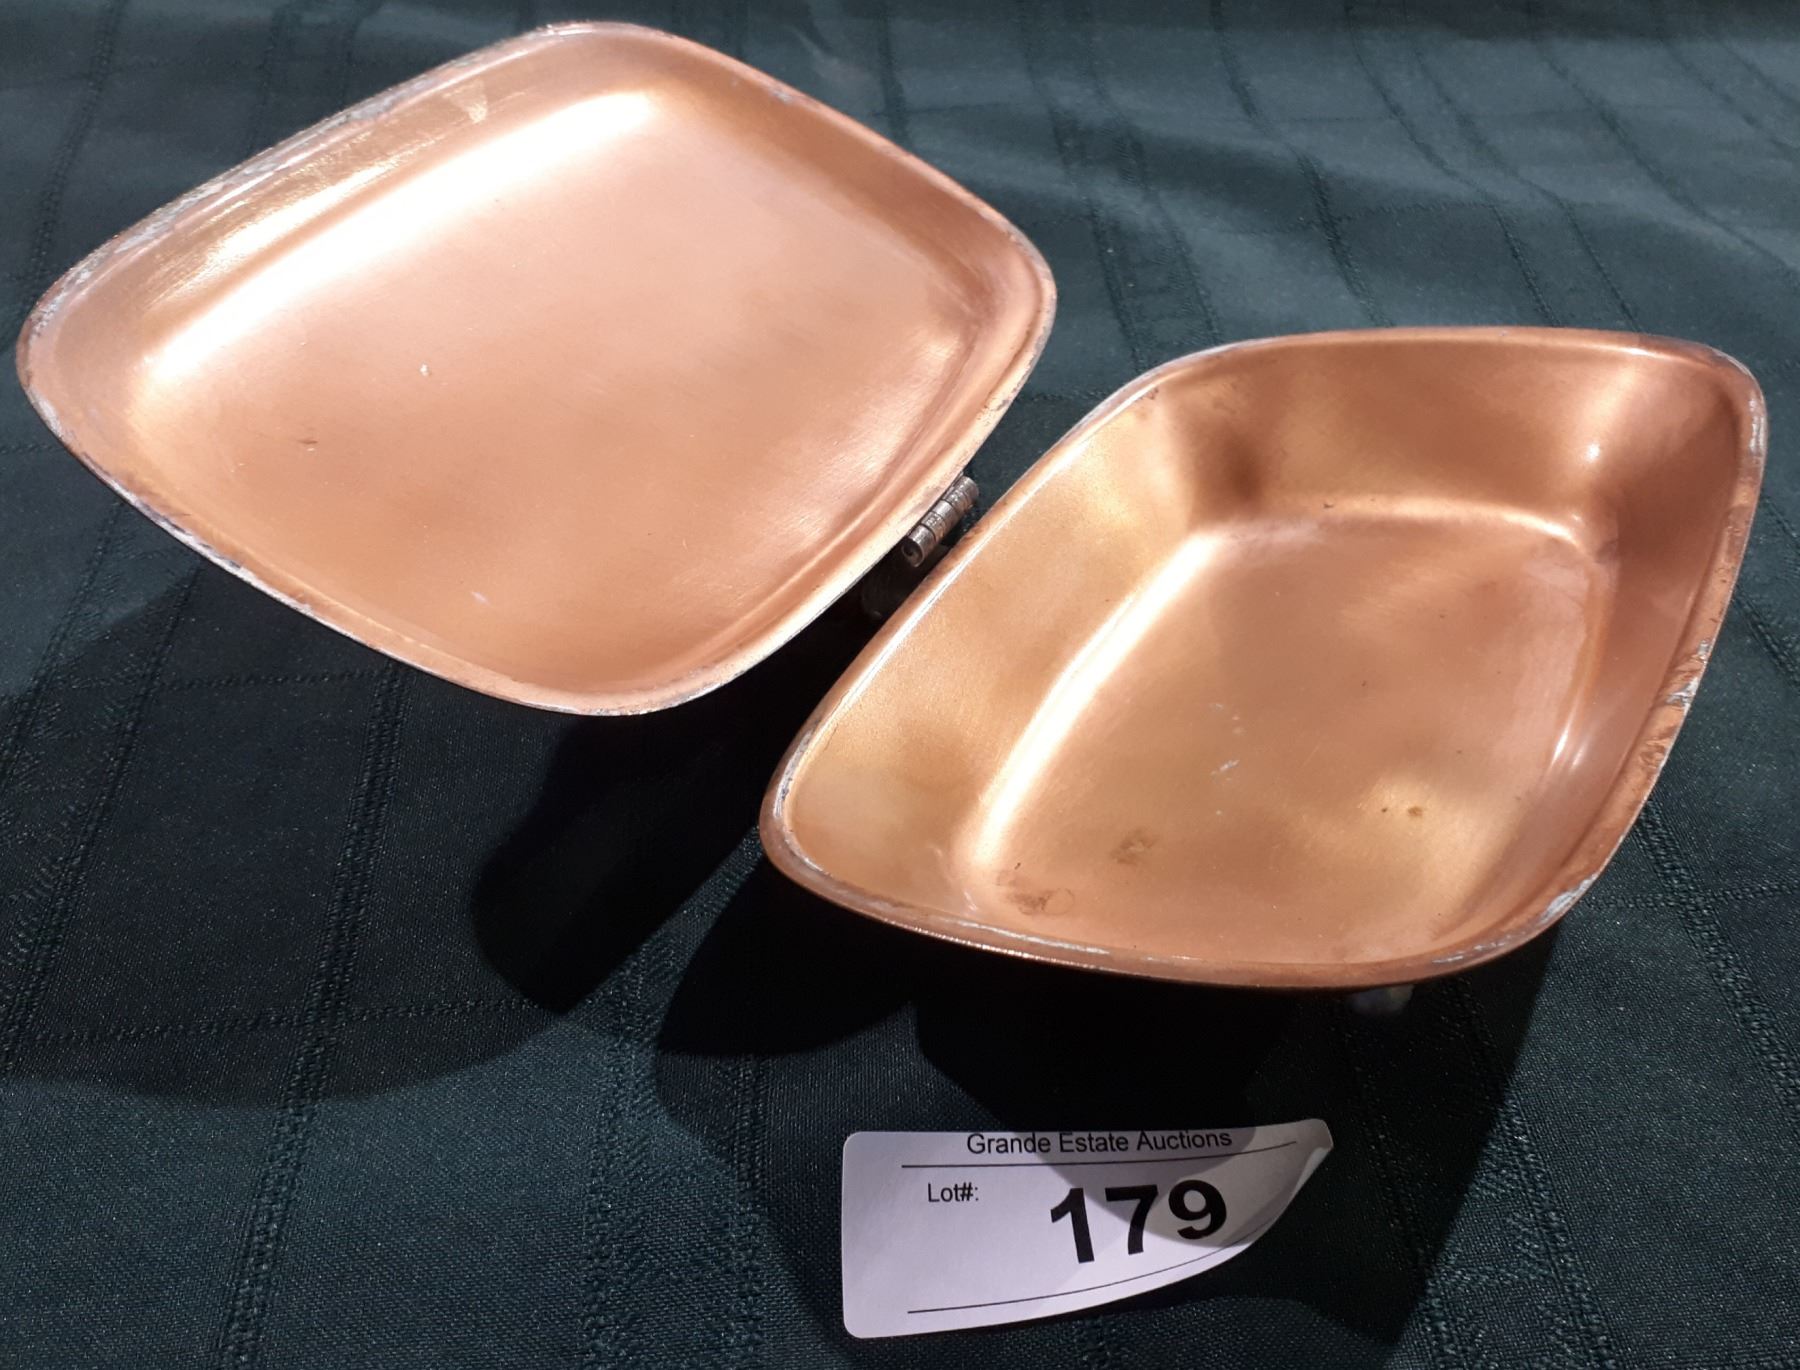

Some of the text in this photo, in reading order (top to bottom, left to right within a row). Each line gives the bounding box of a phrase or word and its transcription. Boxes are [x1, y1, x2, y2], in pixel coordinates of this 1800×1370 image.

[967, 1129, 1233, 1155] Grande Estate Auctions
[927, 1182, 979, 1203] Lot#:
[1050, 1179, 1228, 1264] 179
